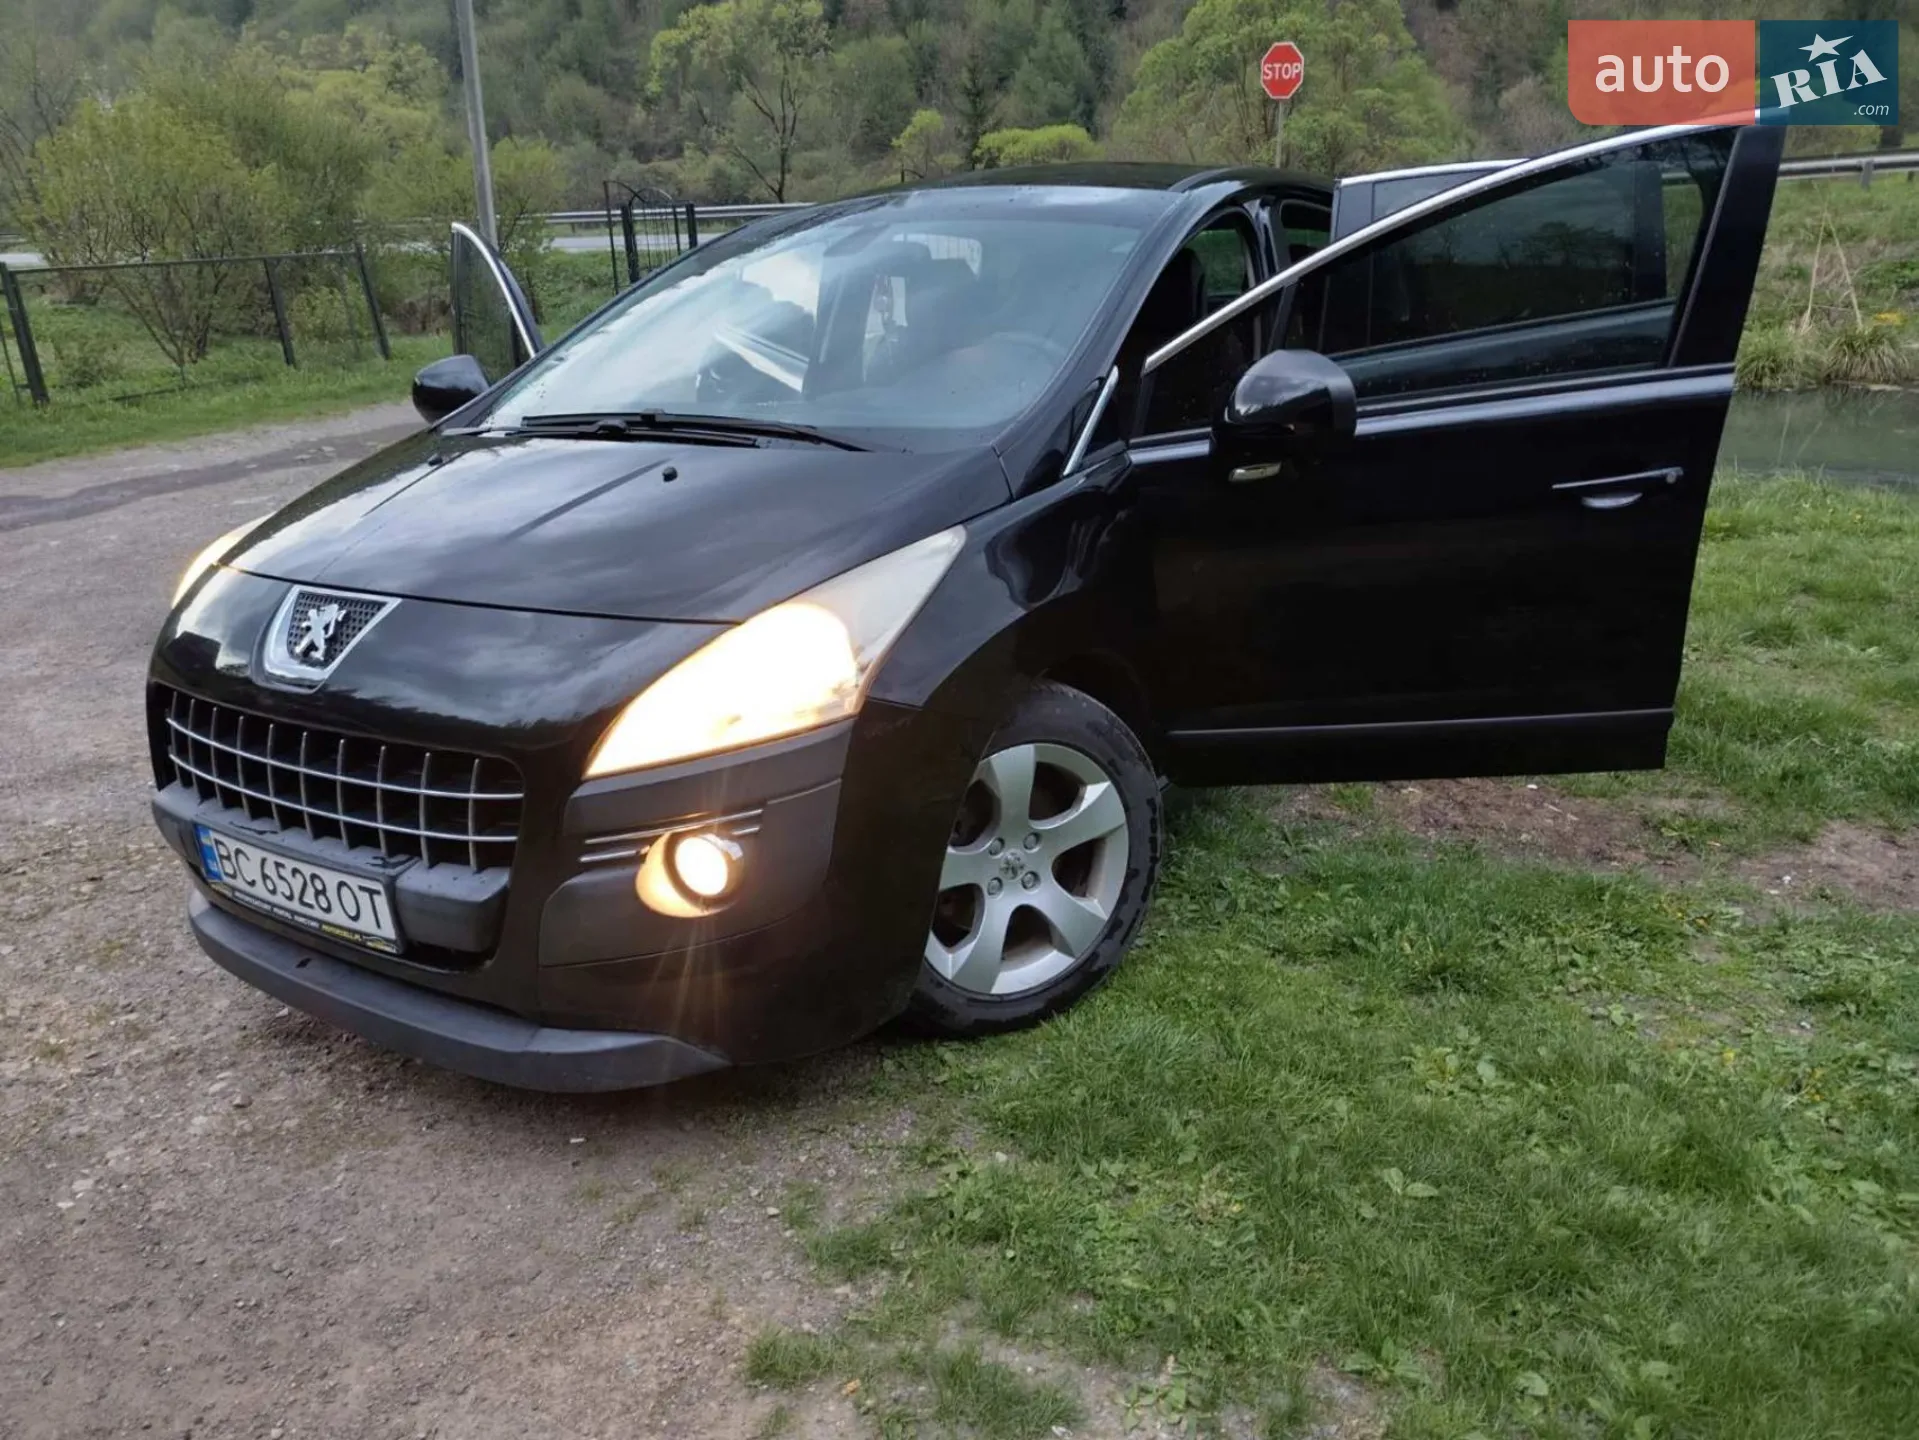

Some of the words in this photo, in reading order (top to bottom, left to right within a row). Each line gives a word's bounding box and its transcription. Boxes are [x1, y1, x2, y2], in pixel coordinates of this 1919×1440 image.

[1263, 62, 1301, 80] STOP
[213, 837, 256, 888] BC
[260, 857, 332, 914] 6528
[336, 880, 382, 930] OT
